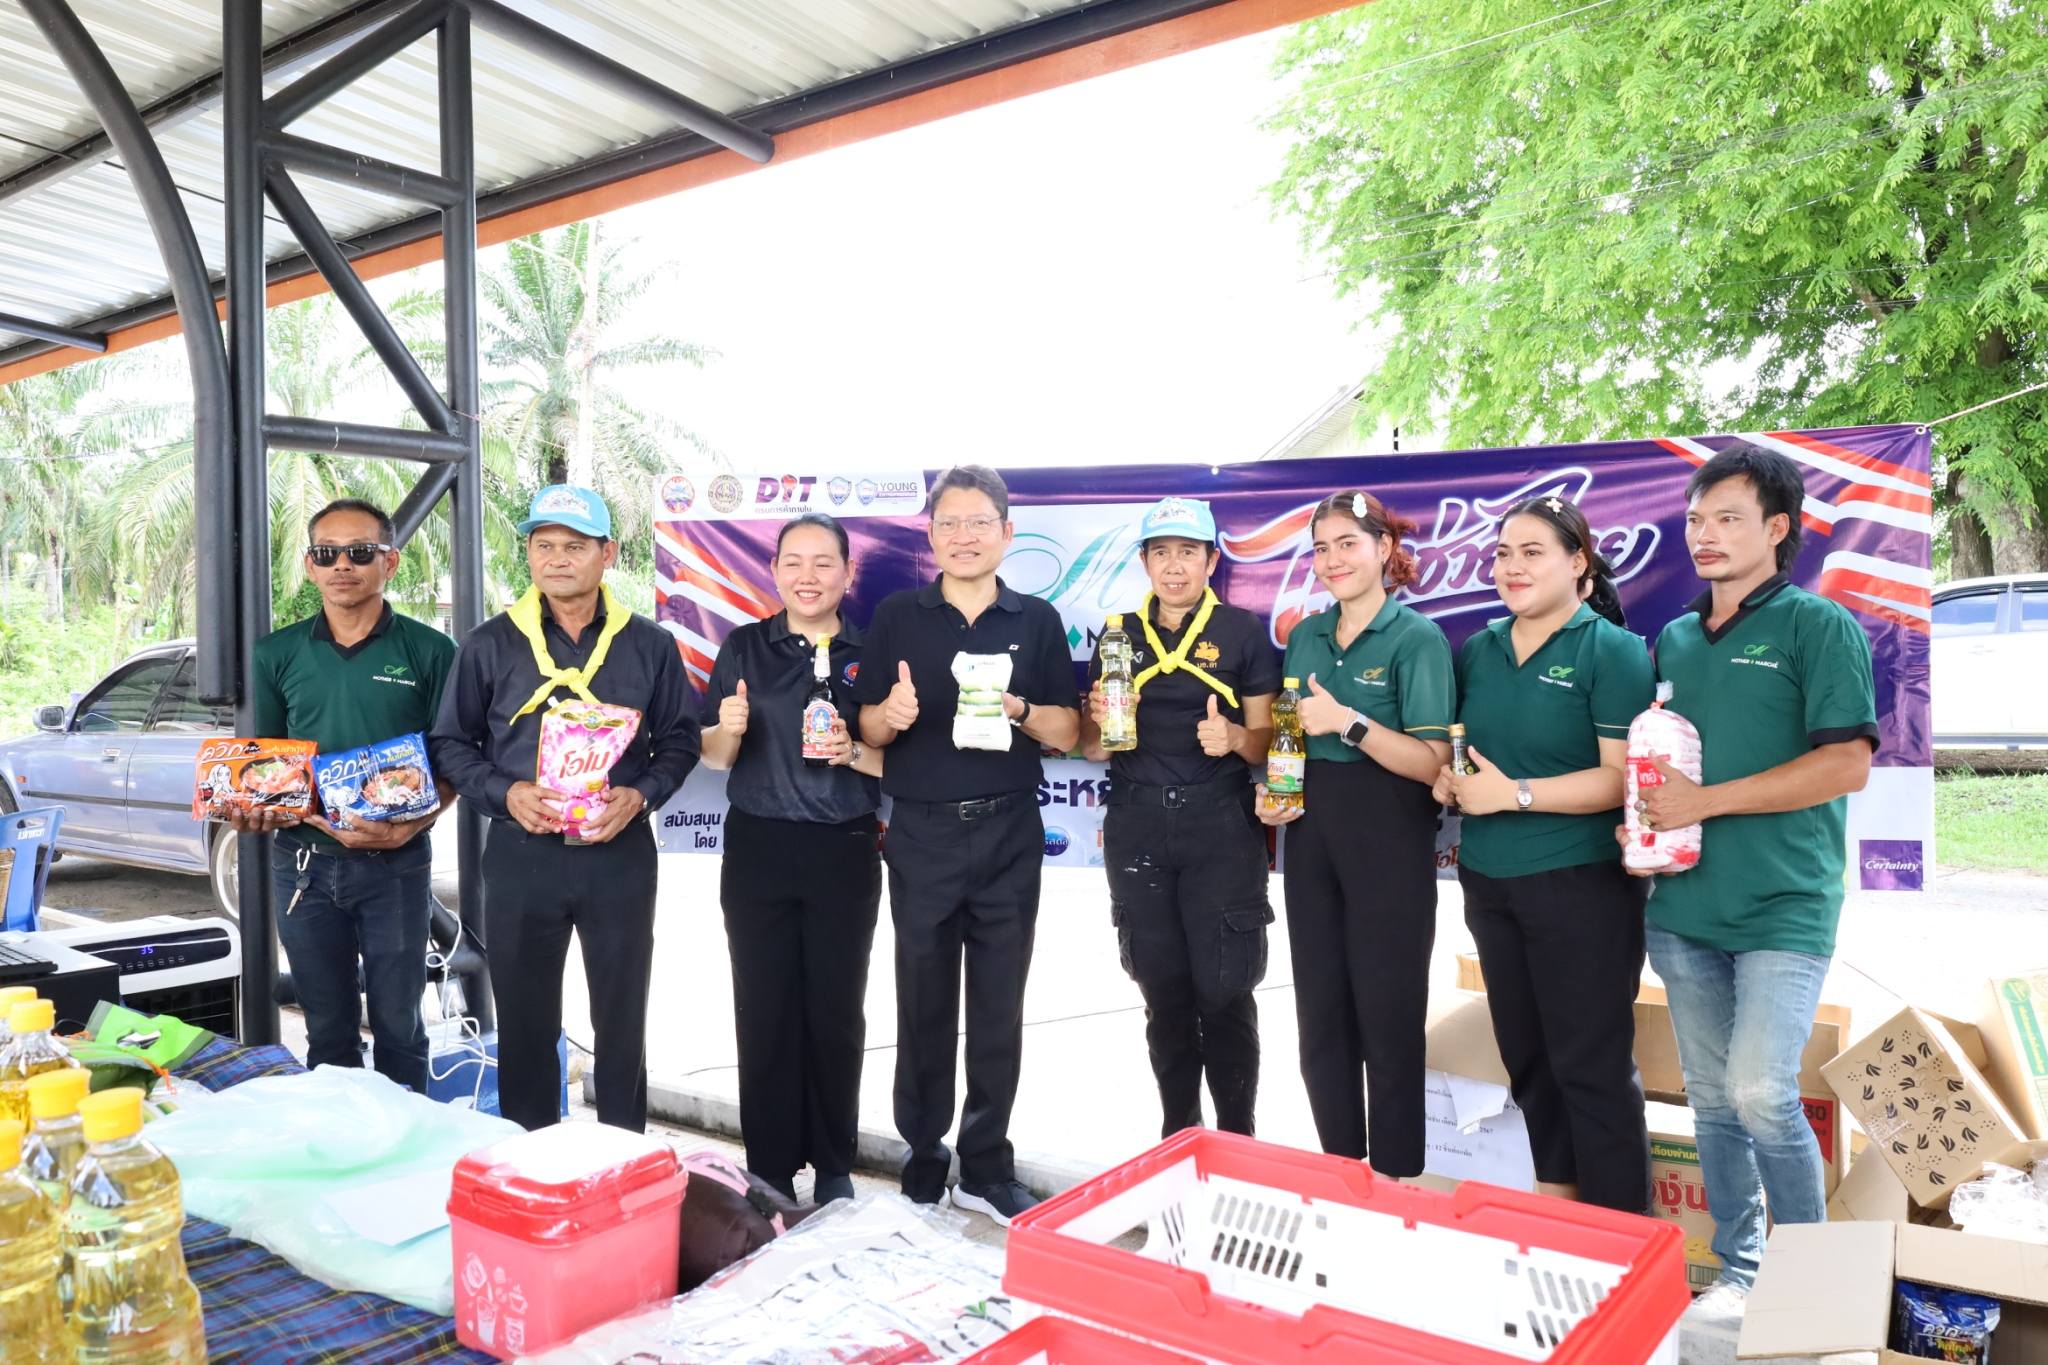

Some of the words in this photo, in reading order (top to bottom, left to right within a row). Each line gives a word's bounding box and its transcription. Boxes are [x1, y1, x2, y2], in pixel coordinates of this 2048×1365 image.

[880, 482, 918, 491] YOUNG
[664, 810, 721, 832] สนับสนุน
[694, 831, 718, 848] โดย
[1865, 860, 1919, 873] Certainty
